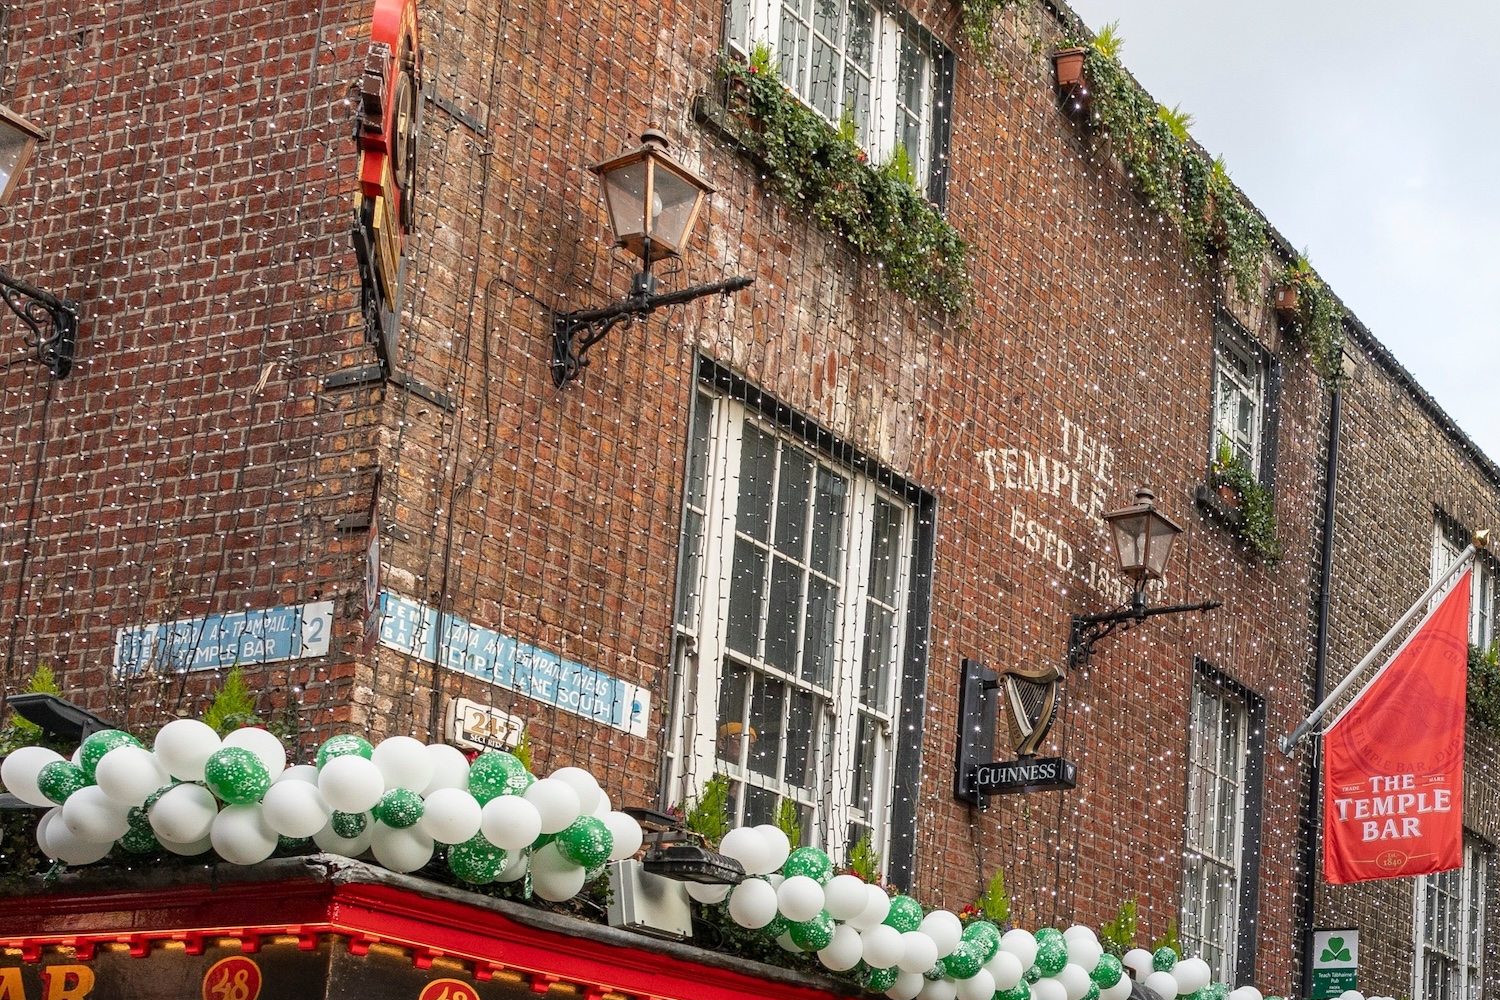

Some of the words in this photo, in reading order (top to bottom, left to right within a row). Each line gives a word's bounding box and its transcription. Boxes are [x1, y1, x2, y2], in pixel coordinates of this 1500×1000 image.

[1058, 413, 1114, 487] THE
[975, 449, 1105, 525] TEMPLE
[308, 617, 324, 643] 2
[243, 638, 276, 658] BAR
[445, 623, 478, 647] LÁNA
[483, 637, 503, 657] AN
[508, 644, 569, 682] TEAMPAILL
[571, 670, 609, 697] THEAS
[509, 667, 552, 698] LANE
[558, 688, 611, 718] SOUTH
[630, 701, 642, 723] 2
[977, 764, 1056, 785] GUINNESS
[1368, 774, 1416, 794] THE
[1428, 775, 1445, 783] MARK
[1334, 789, 1452, 822] TEMPLE
[1361, 817, 1422, 842] BAR
[1382, 858, 1402, 867] 1840
